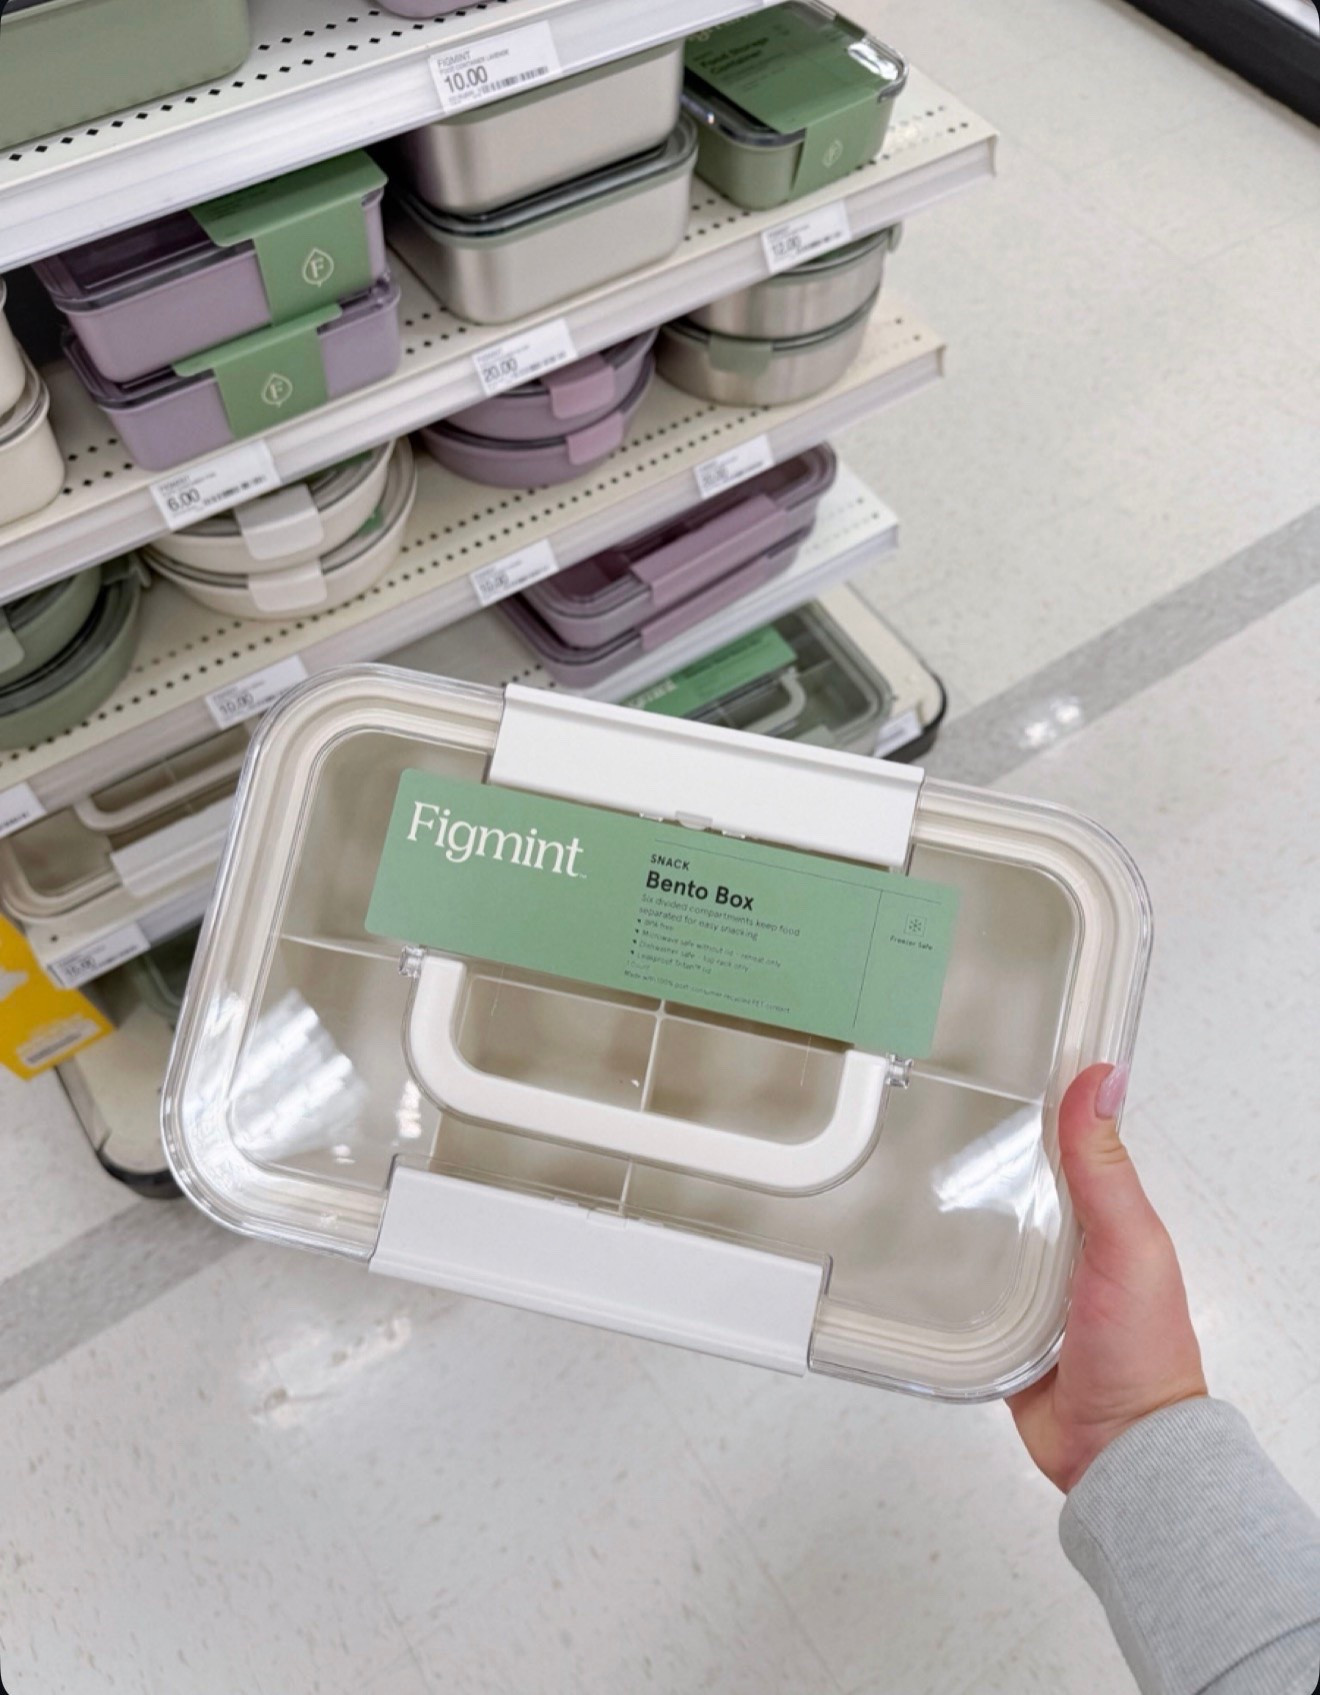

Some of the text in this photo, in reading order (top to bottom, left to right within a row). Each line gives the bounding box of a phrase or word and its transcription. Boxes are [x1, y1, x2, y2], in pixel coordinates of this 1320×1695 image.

[437, 51, 471, 67] FIGMINT
[444, 65, 488, 93] 10.00
[482, 358, 519, 383] 20.00
[167, 488, 200, 512] 6.00
[650, 853, 691, 871] SNACK
[646, 870, 755, 911] Bento Box
[638, 905, 758, 941] separated for easy snacking
[641, 892, 800, 937] Six divided compartments keep food
[890, 935, 916, 946] Freezer
